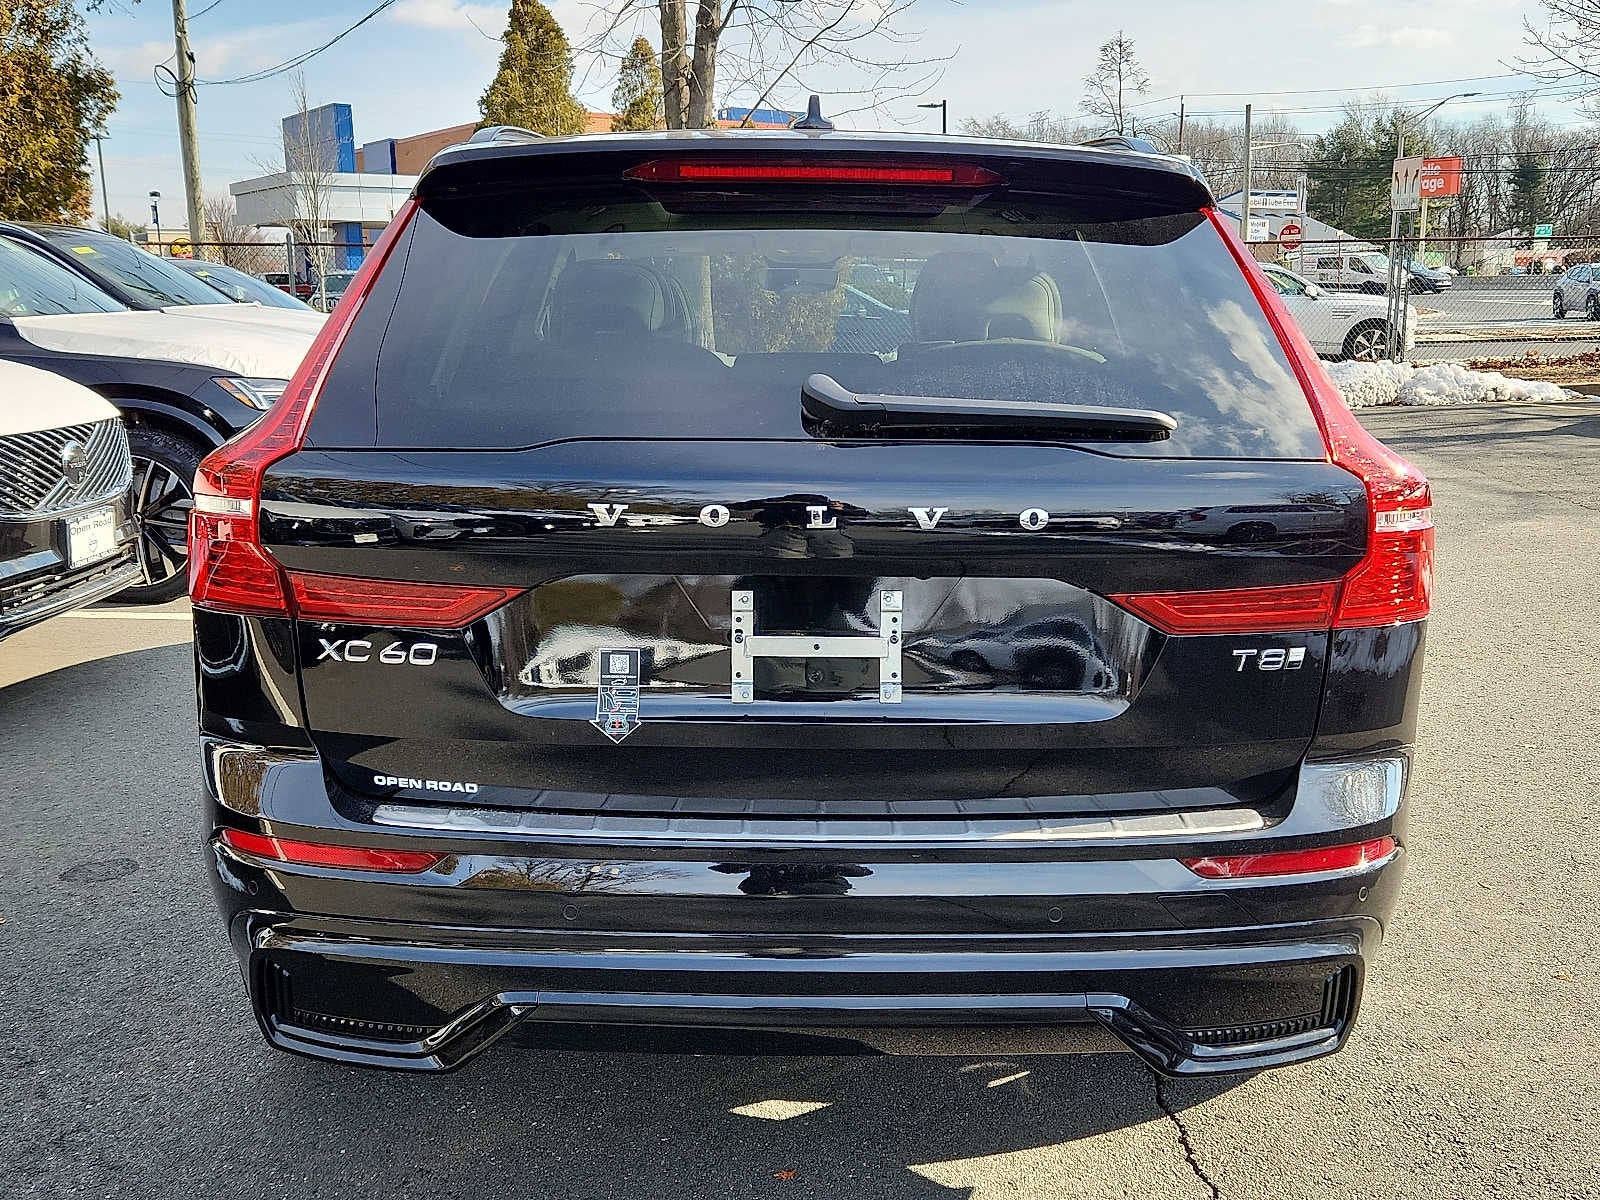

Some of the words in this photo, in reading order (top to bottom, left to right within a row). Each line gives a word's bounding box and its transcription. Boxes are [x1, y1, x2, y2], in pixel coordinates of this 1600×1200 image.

[1421, 178, 1445, 192] age
[587, 503, 1050, 531] VOLVO
[1231, 648, 1286, 672] T8
[373, 775, 422, 790] OPEN
[425, 779, 479, 794] ROAD
